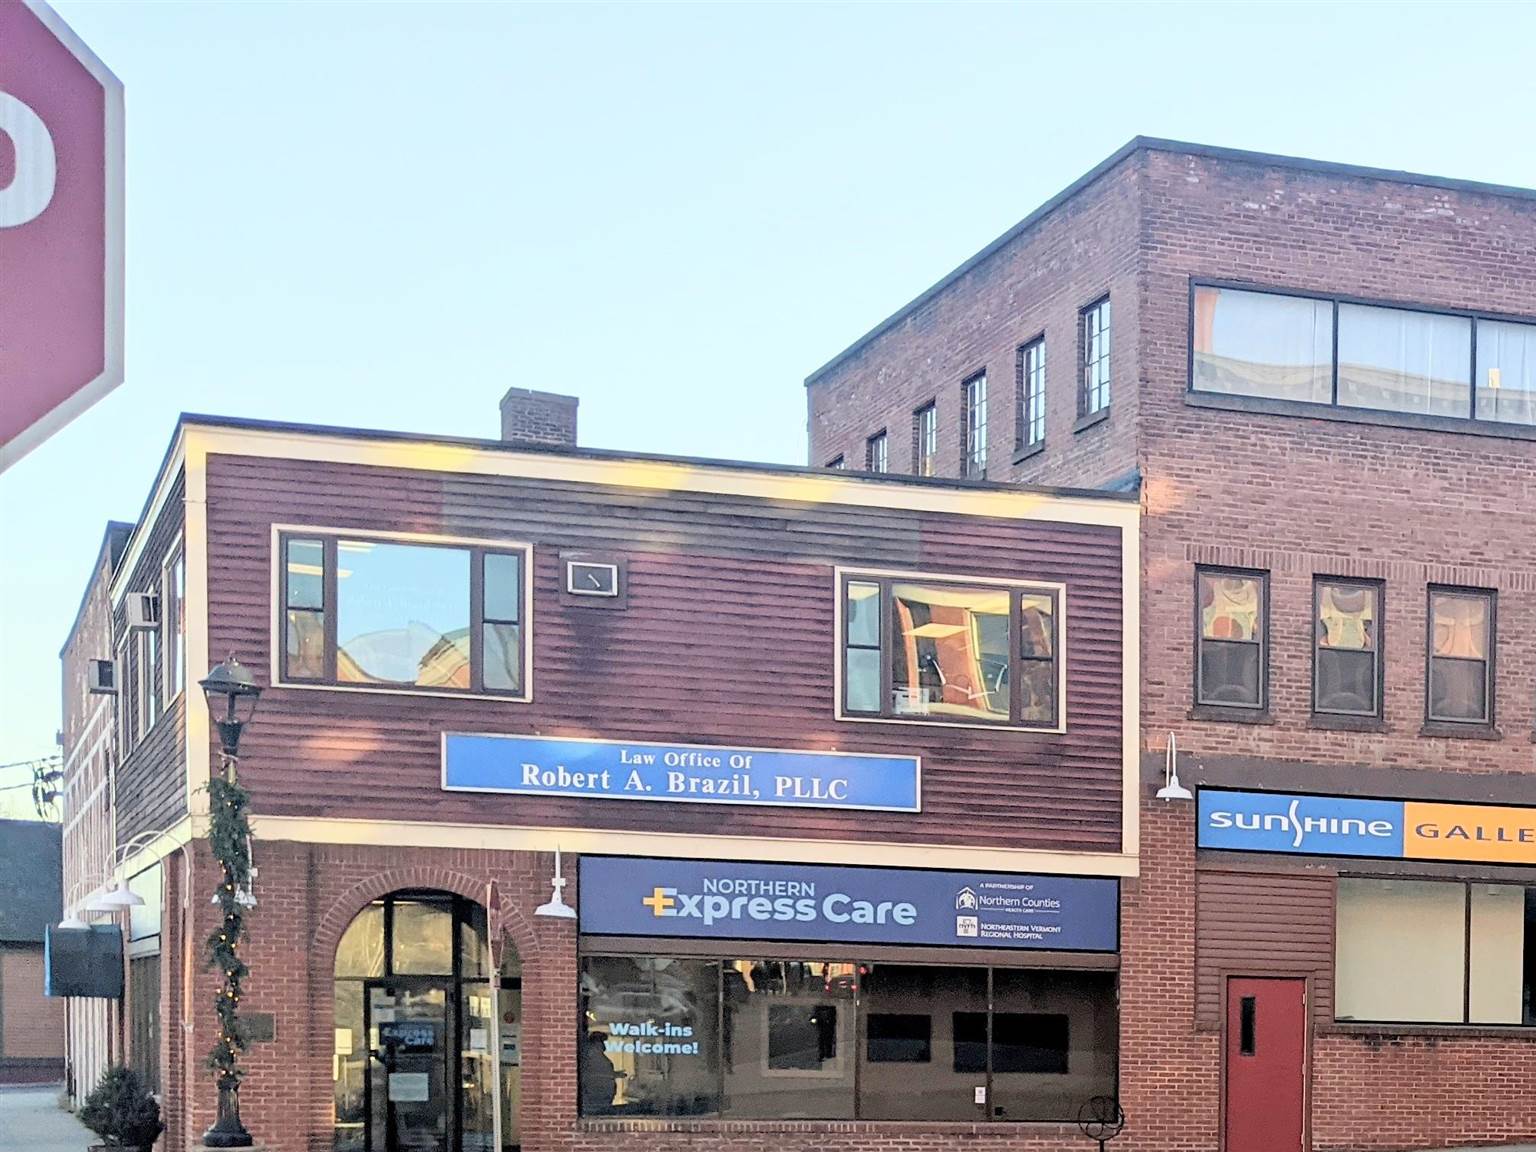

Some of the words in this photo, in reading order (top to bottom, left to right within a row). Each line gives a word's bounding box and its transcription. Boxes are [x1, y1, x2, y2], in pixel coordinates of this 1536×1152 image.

[620, 750, 656, 765] Law
[665, 752, 721, 768] Office
[729, 754, 753, 769] Of
[520, 763, 611, 790] Robert
[624, 771, 652, 792] A.
[667, 772, 761, 799] Brazil,
[775, 776, 849, 800] PLLC
[703, 878, 816, 896] NORTHERN
[653, 887, 817, 925] Express
[822, 893, 918, 925] Care
[979, 896, 1021, 906] Northern
[1022, 897, 1061, 908] Counties
[980, 930, 1011, 939] REGIONAL
[1013, 931, 1043, 940] HOSPITAL
[981, 923, 1029, 932] NORTHEASTERN
[1031, 924, 1062, 933] VERMONT
[608, 1022, 693, 1038] Walk-ins
[603, 1040, 699, 1055] Welcome!
